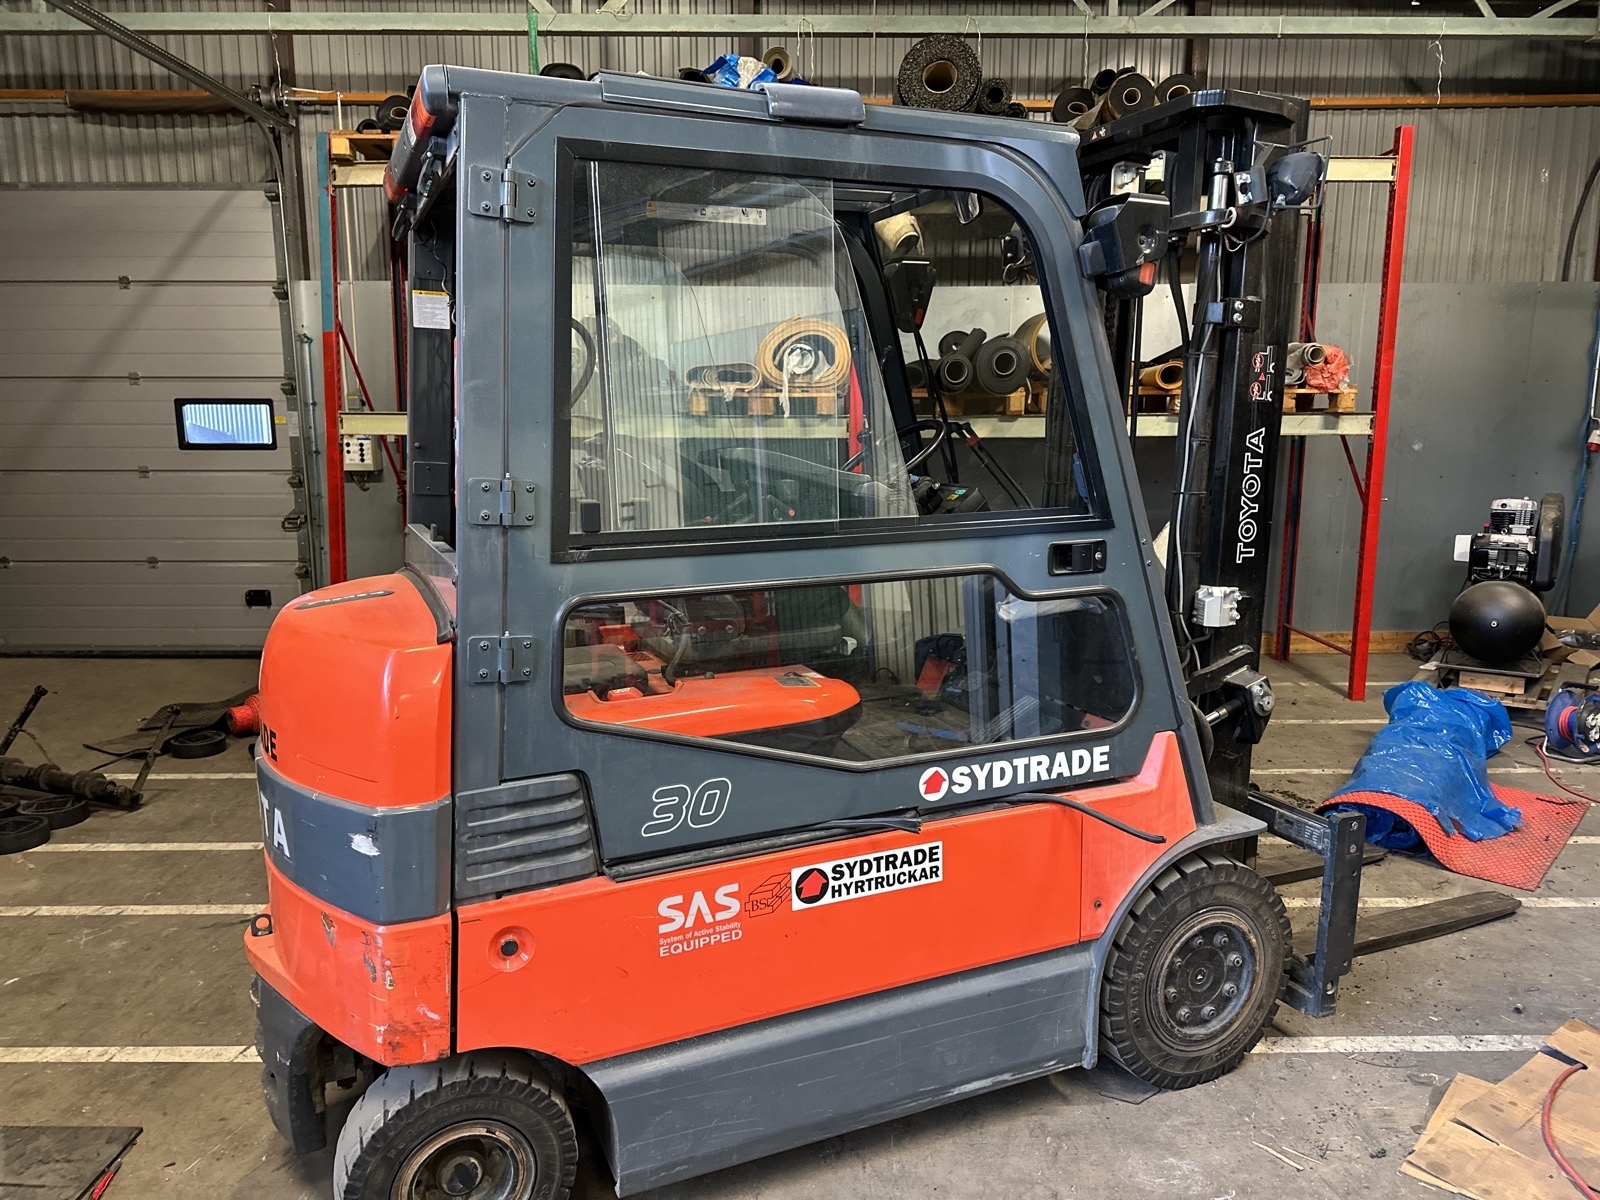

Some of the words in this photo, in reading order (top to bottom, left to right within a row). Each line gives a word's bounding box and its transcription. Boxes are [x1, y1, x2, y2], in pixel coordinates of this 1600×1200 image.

[1236, 427, 1265, 563] TOYOTA
[951, 745, 1110, 794] SYDTRADE
[641, 777, 732, 837] 30
[831, 845, 940, 881] SYDTRADE
[831, 865, 940, 899] HYRTRUCKAR
[658, 883, 740, 934] SAS
[659, 936, 684, 946] System
[685, 930, 692, 940] of
[693, 927, 713, 938] Active
[715, 921, 741, 933] Stability
[660, 929, 742, 957] EQUIPPED
